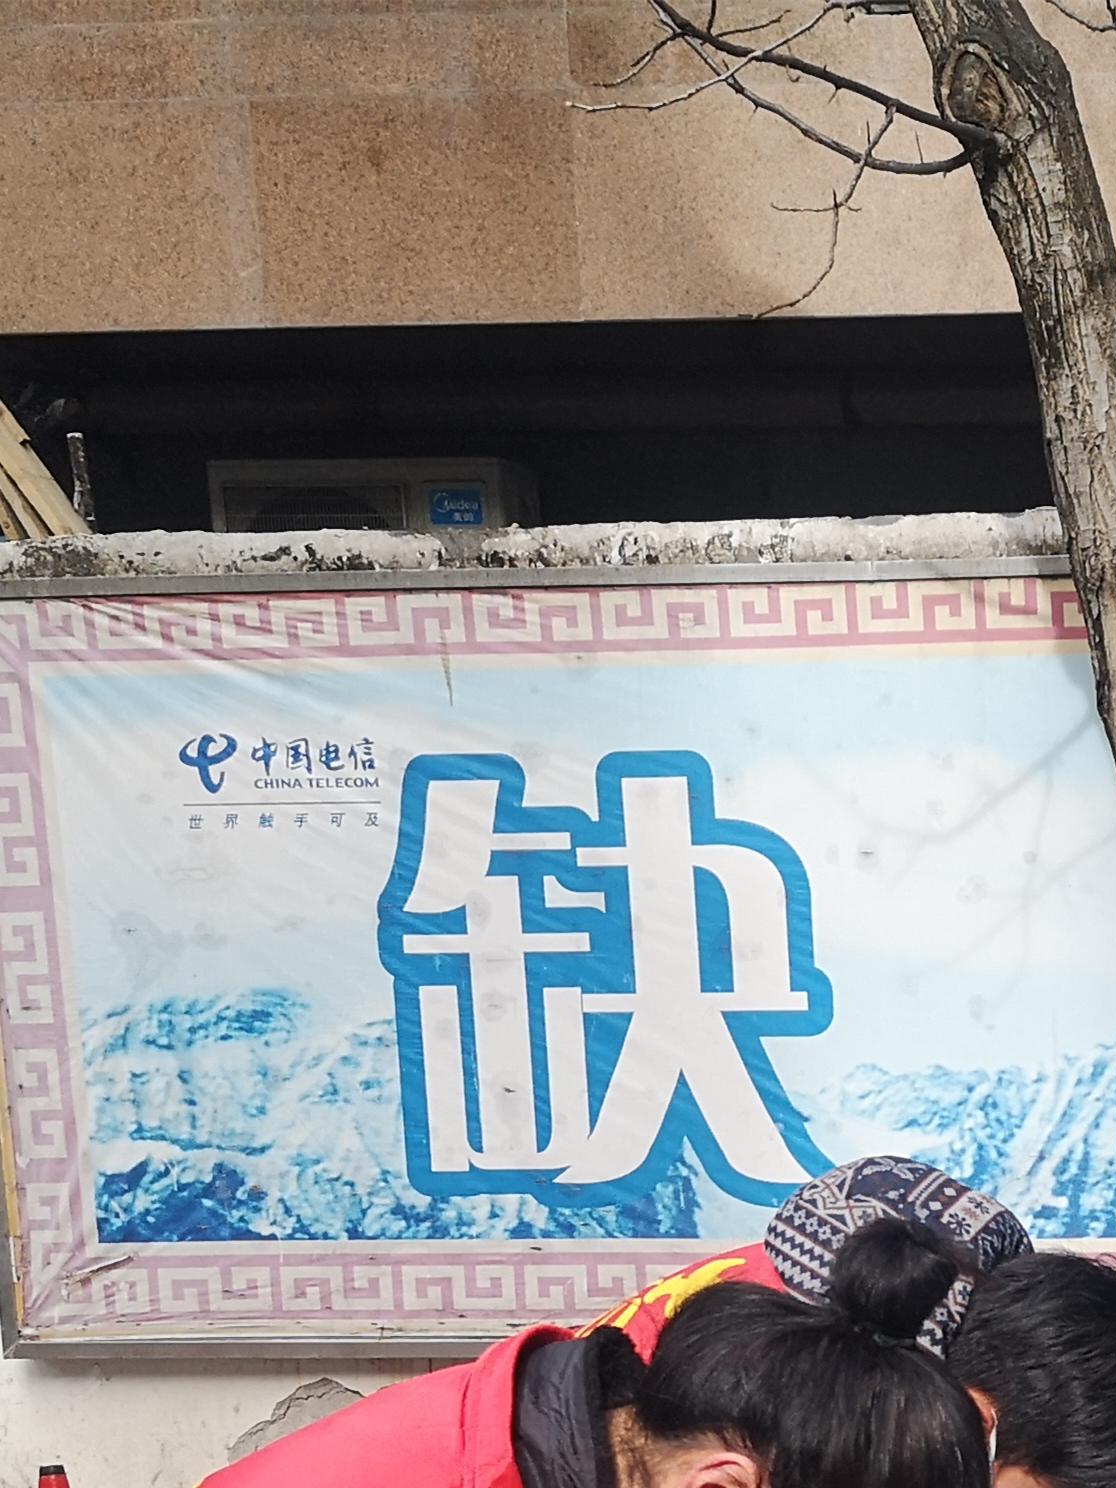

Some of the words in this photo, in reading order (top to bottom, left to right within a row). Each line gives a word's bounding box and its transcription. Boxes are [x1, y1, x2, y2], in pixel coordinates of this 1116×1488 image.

[251, 737, 377, 775] 中国电信
[254, 778, 300, 789] CHINA
[307, 777, 380, 789] TELECOM
[188, 812, 379, 830] 世界触手可及
